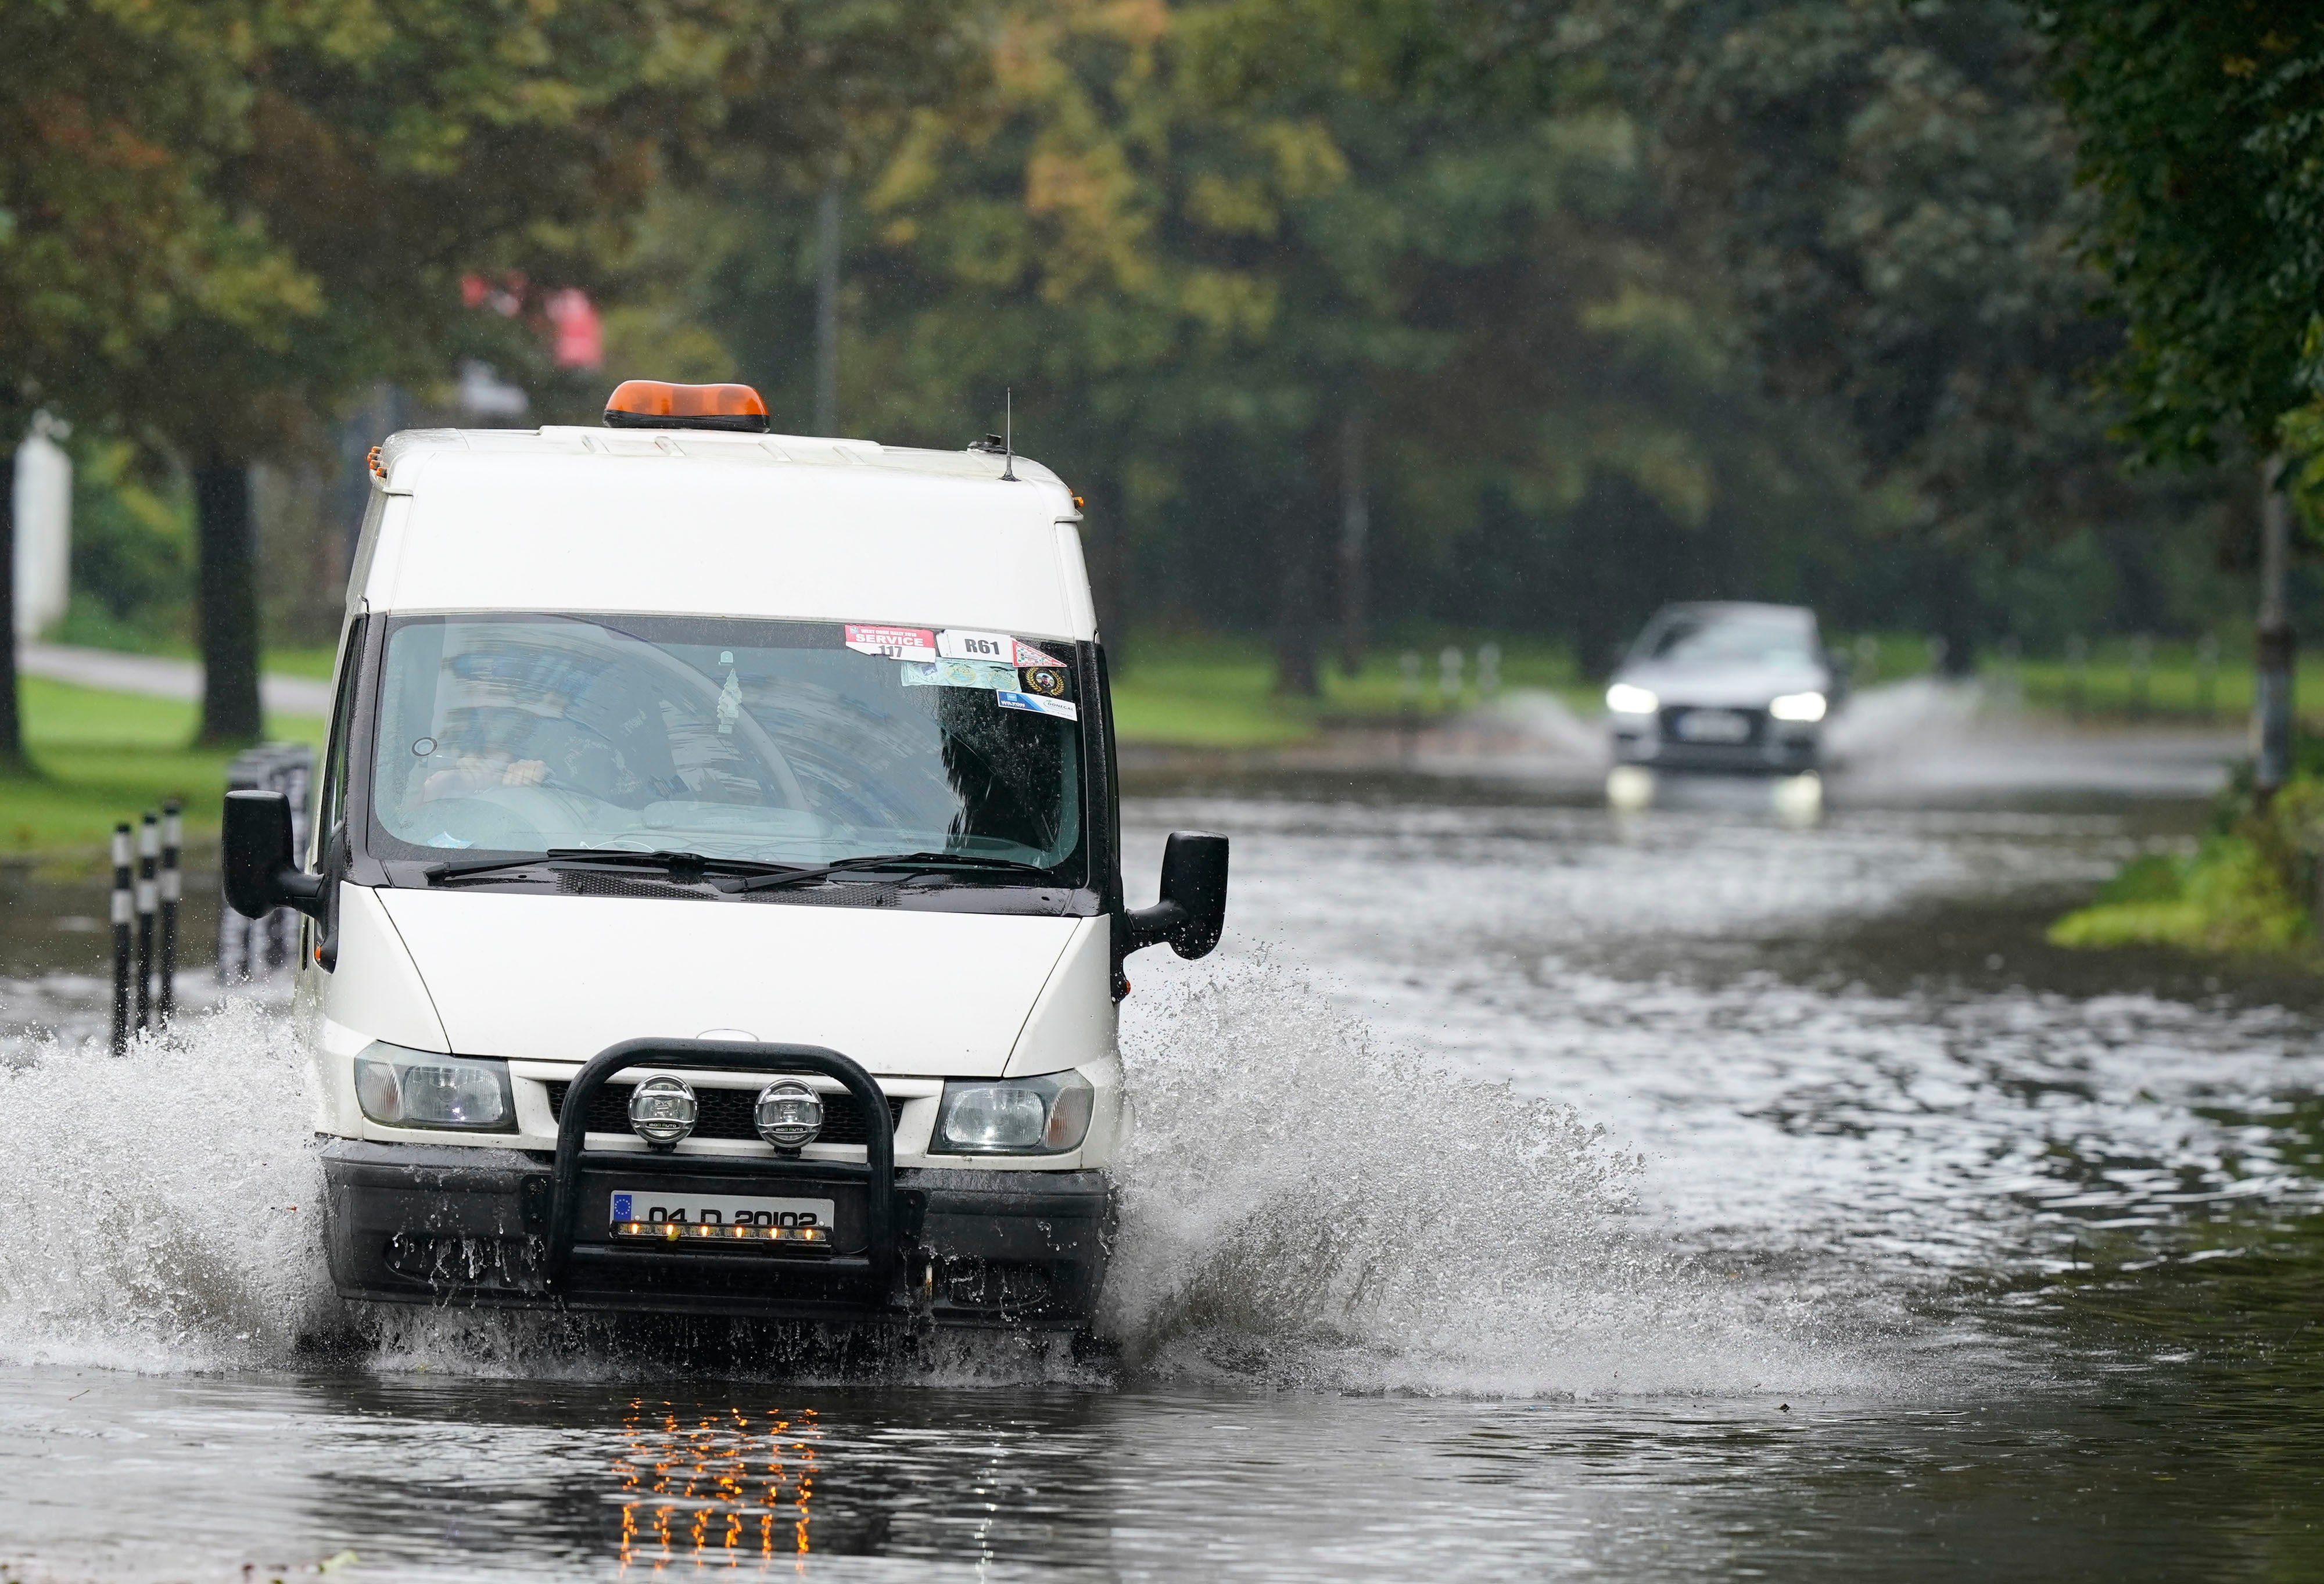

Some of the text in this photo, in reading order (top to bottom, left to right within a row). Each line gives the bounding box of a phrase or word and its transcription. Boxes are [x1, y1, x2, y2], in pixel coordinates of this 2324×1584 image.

[855, 633, 924, 646] SERVICE
[878, 645, 902, 658] 117
[964, 638, 1000, 655] R61
[1000, 700, 1025, 708] WILTON
[1048, 702, 1074, 712] DONEGAL
[648, 1206, 817, 1227] 04 D 20102
